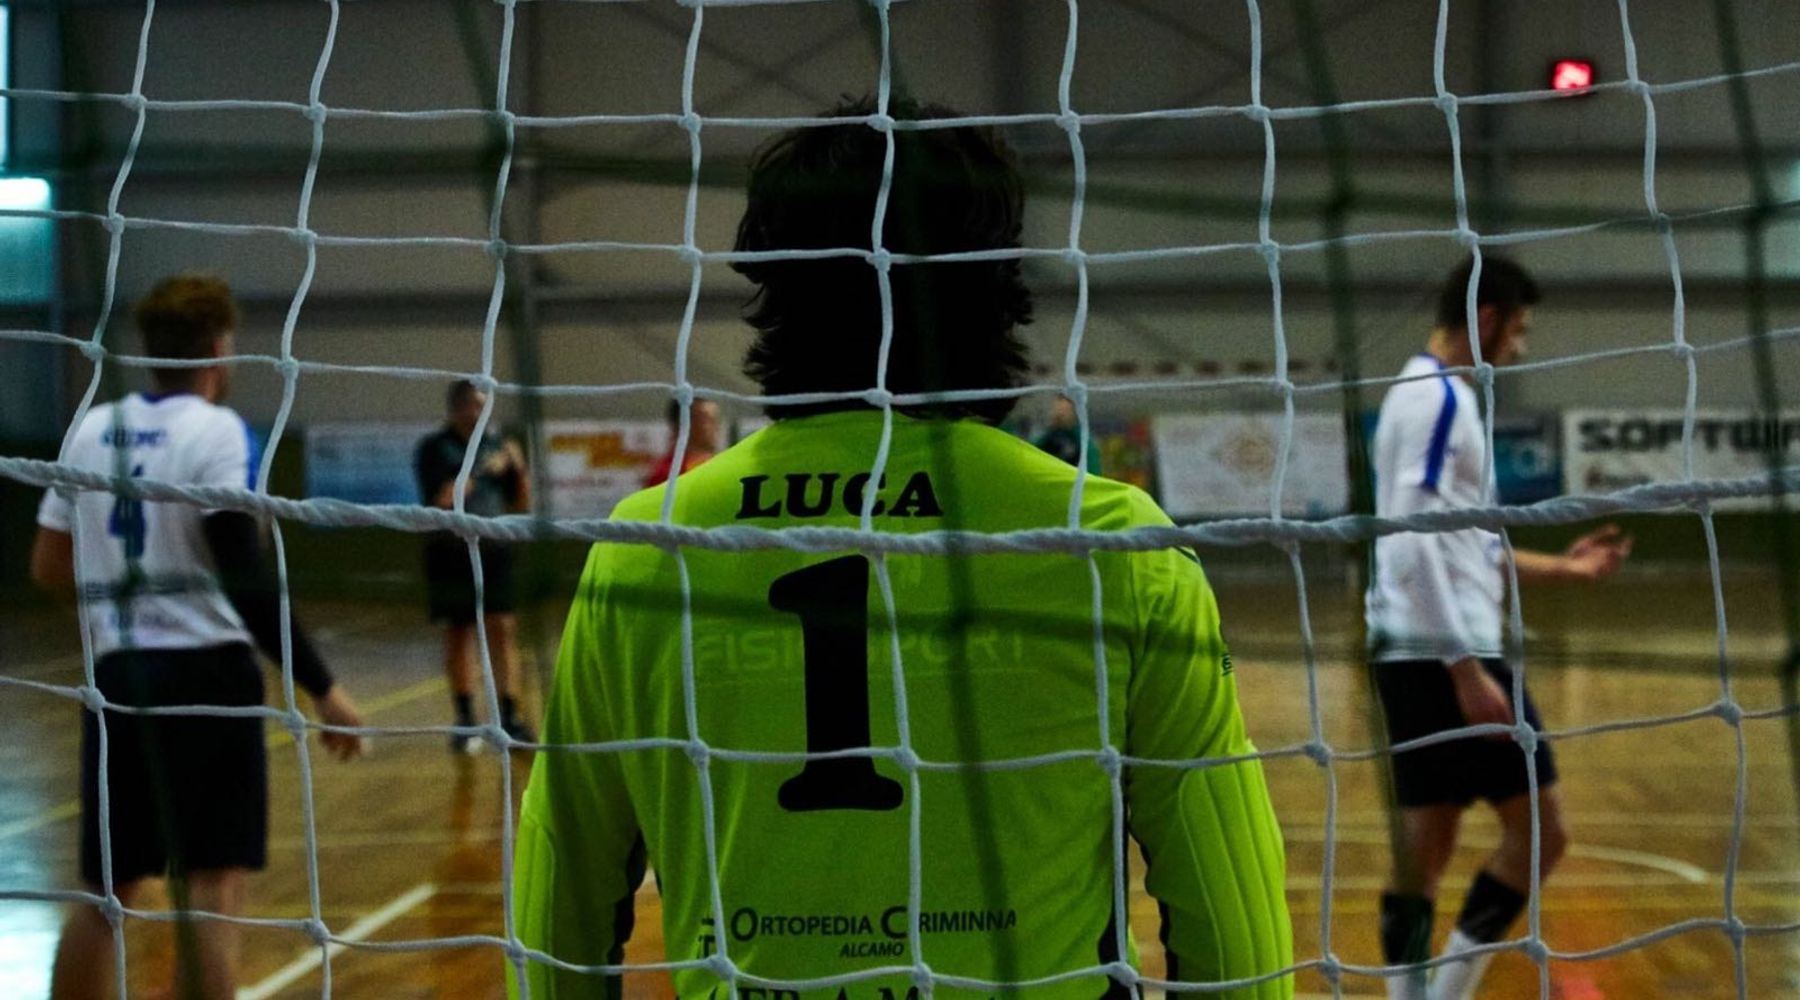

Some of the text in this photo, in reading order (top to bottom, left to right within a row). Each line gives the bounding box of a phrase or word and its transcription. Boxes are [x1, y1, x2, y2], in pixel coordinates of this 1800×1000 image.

[736, 472, 943, 519] LUCA
[769, 555, 904, 811] 1
[840, 942, 904, 957] ALCAMO
